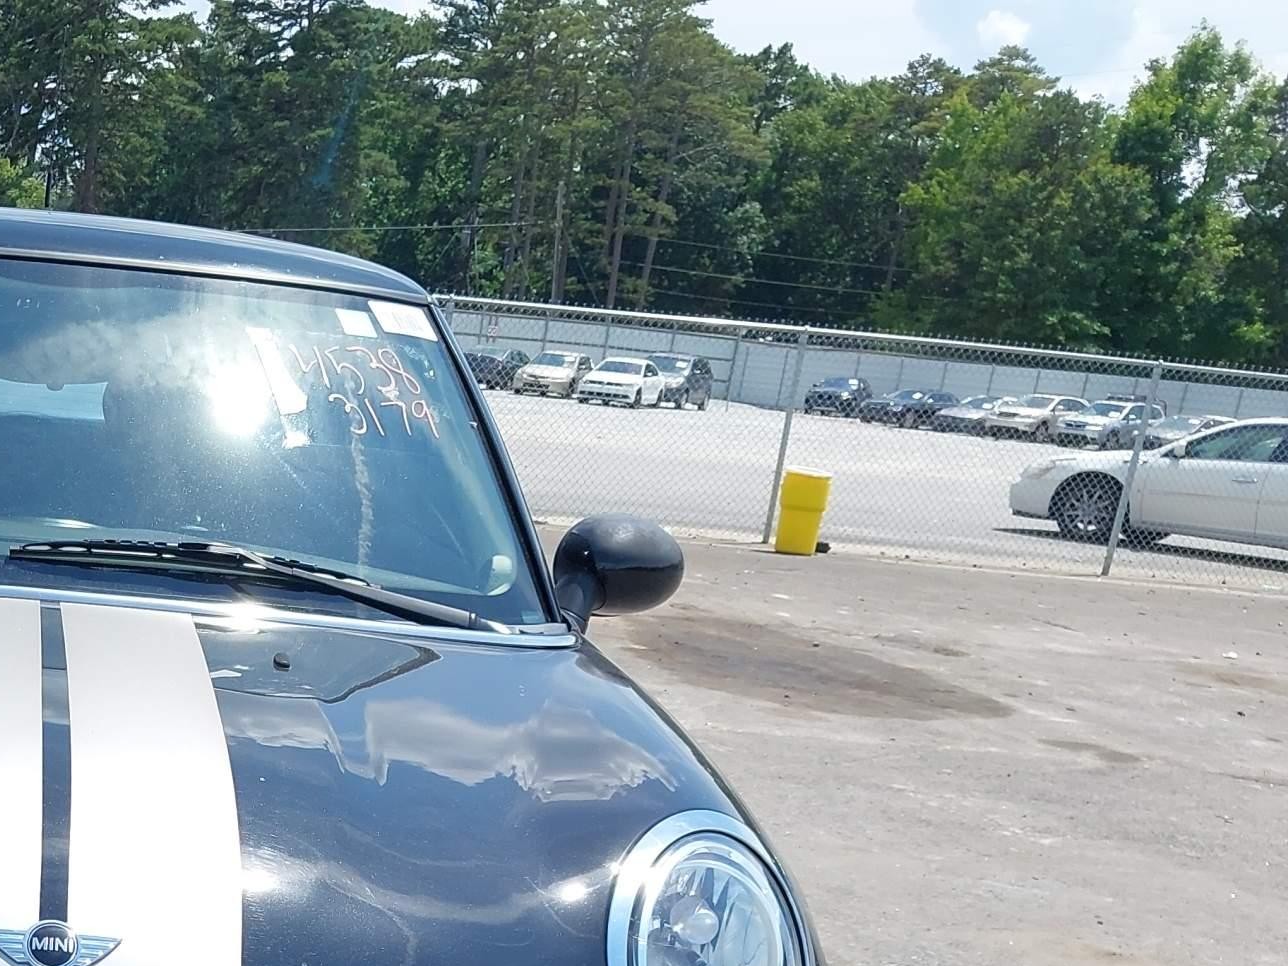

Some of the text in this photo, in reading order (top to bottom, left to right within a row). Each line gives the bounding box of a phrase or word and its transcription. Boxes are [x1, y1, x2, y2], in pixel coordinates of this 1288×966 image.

[288, 343, 421, 395] 4538
[328, 393, 440, 439] 3179
[31, 936, 74, 953] MINI
